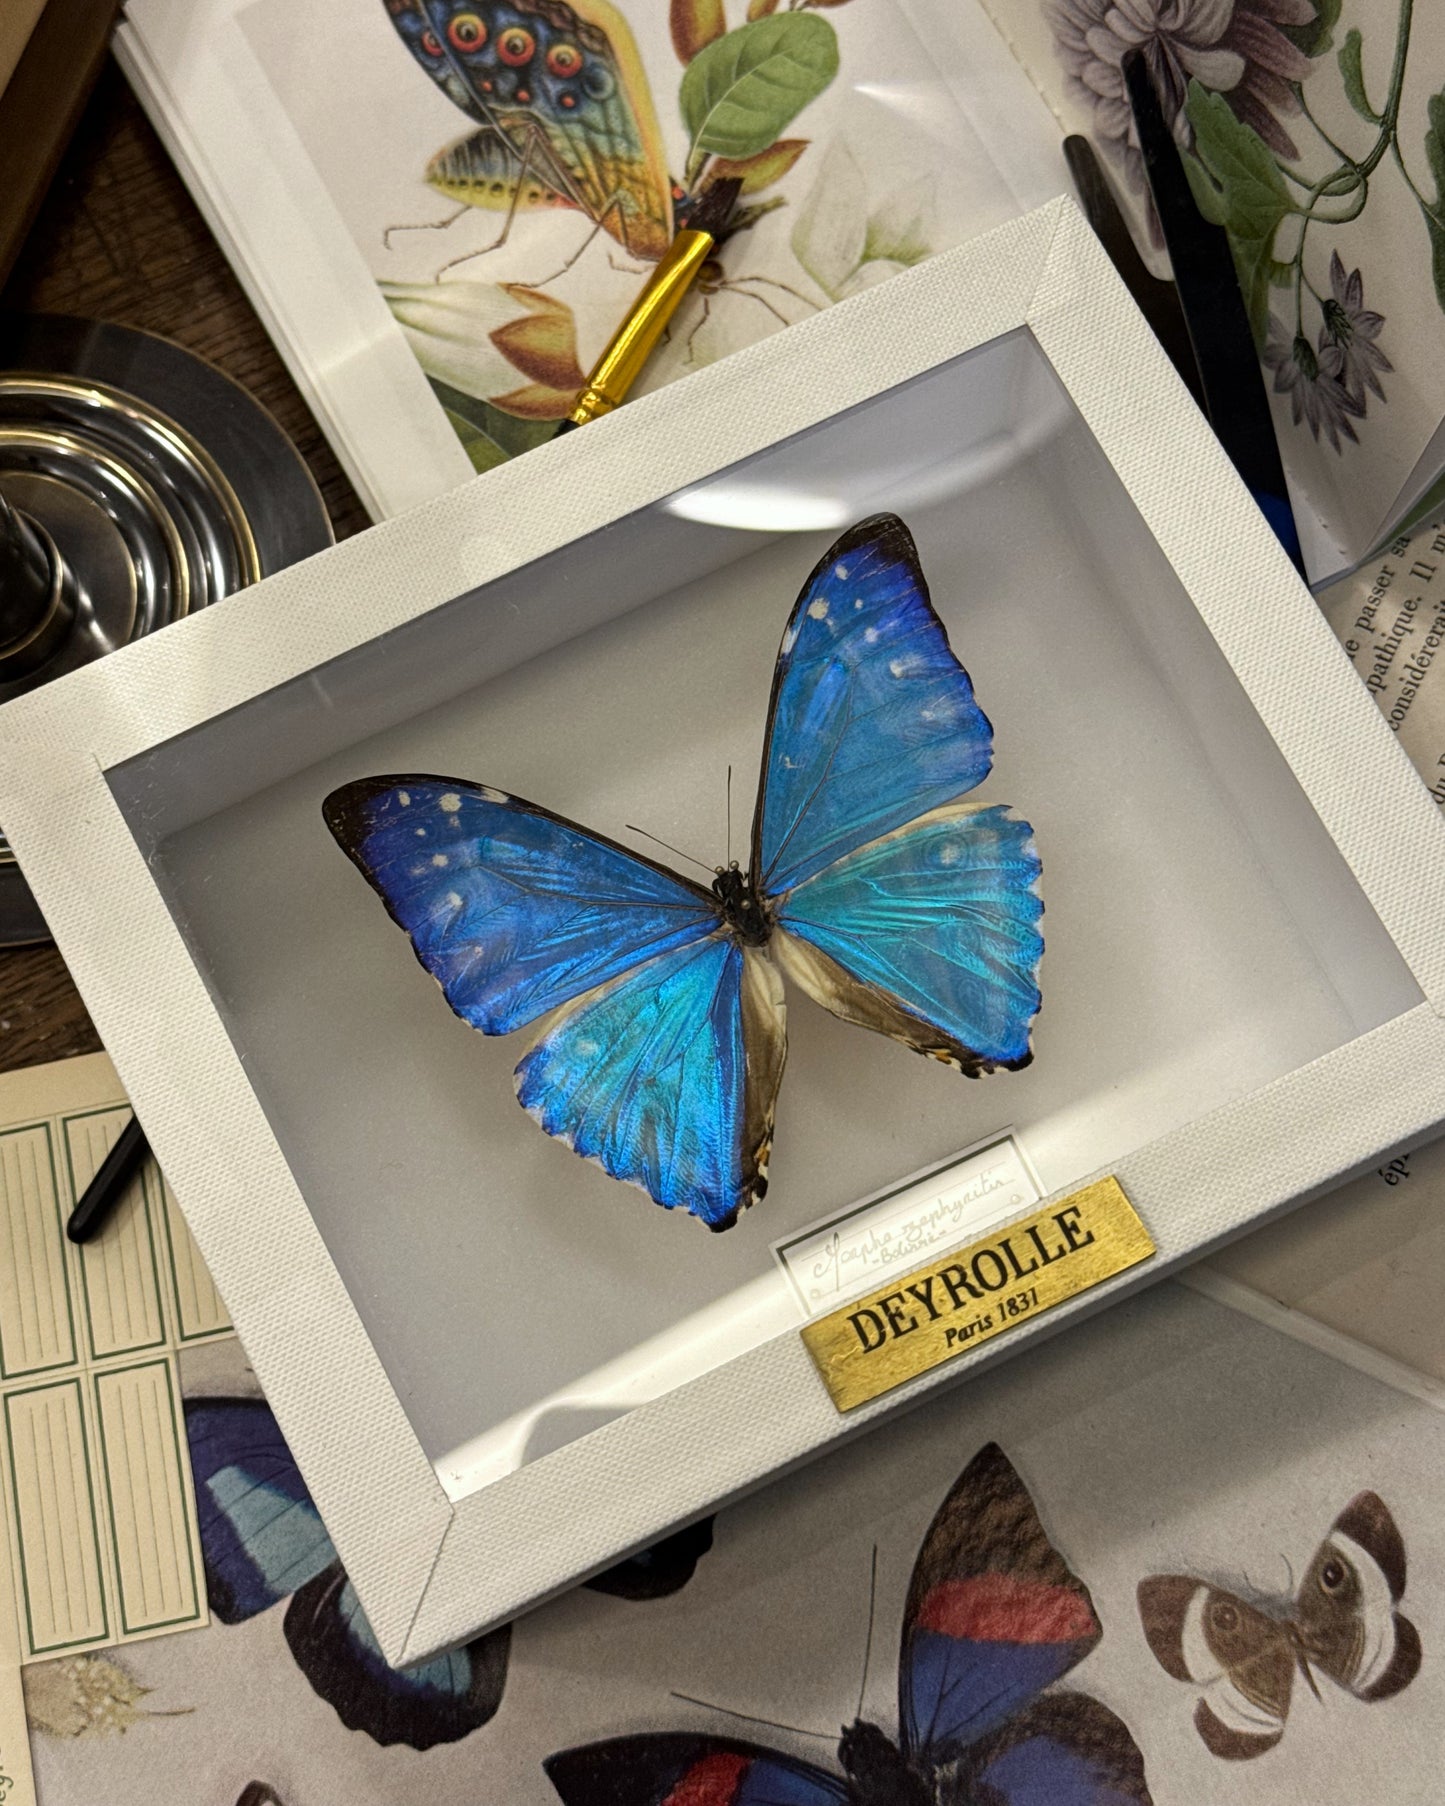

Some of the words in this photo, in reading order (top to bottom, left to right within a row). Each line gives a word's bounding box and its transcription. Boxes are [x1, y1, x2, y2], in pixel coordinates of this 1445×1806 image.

[1354, 565, 1395, 634] passer
[1391, 537, 1411, 558] sa
[1409, 561, 1437, 583] Il
[1377, 1153, 1410, 1187] ép
[847, 1205, 1096, 1354] DEYROLLE
[943, 1312, 993, 1349] Paris
[998, 1287, 1040, 1323] 1831
